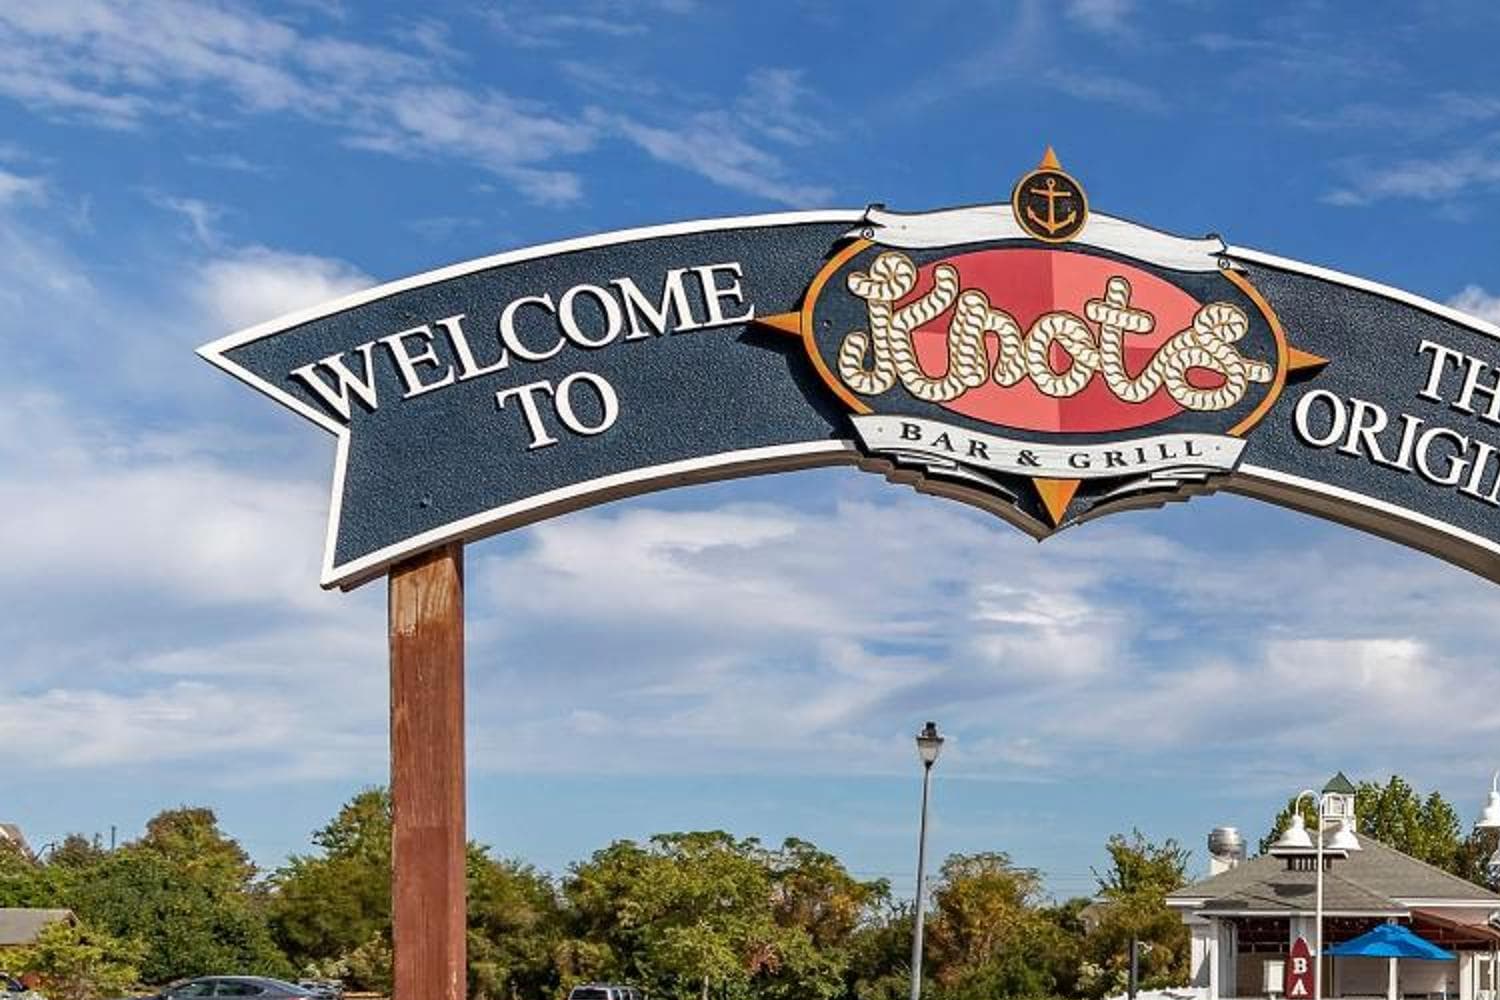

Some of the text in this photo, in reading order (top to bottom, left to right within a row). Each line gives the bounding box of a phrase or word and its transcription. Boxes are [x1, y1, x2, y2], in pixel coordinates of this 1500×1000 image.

[291, 262, 755, 424] WELCOME
[496, 372, 620, 450] TO
[901, 421, 1203, 470] BAR & GRILL
